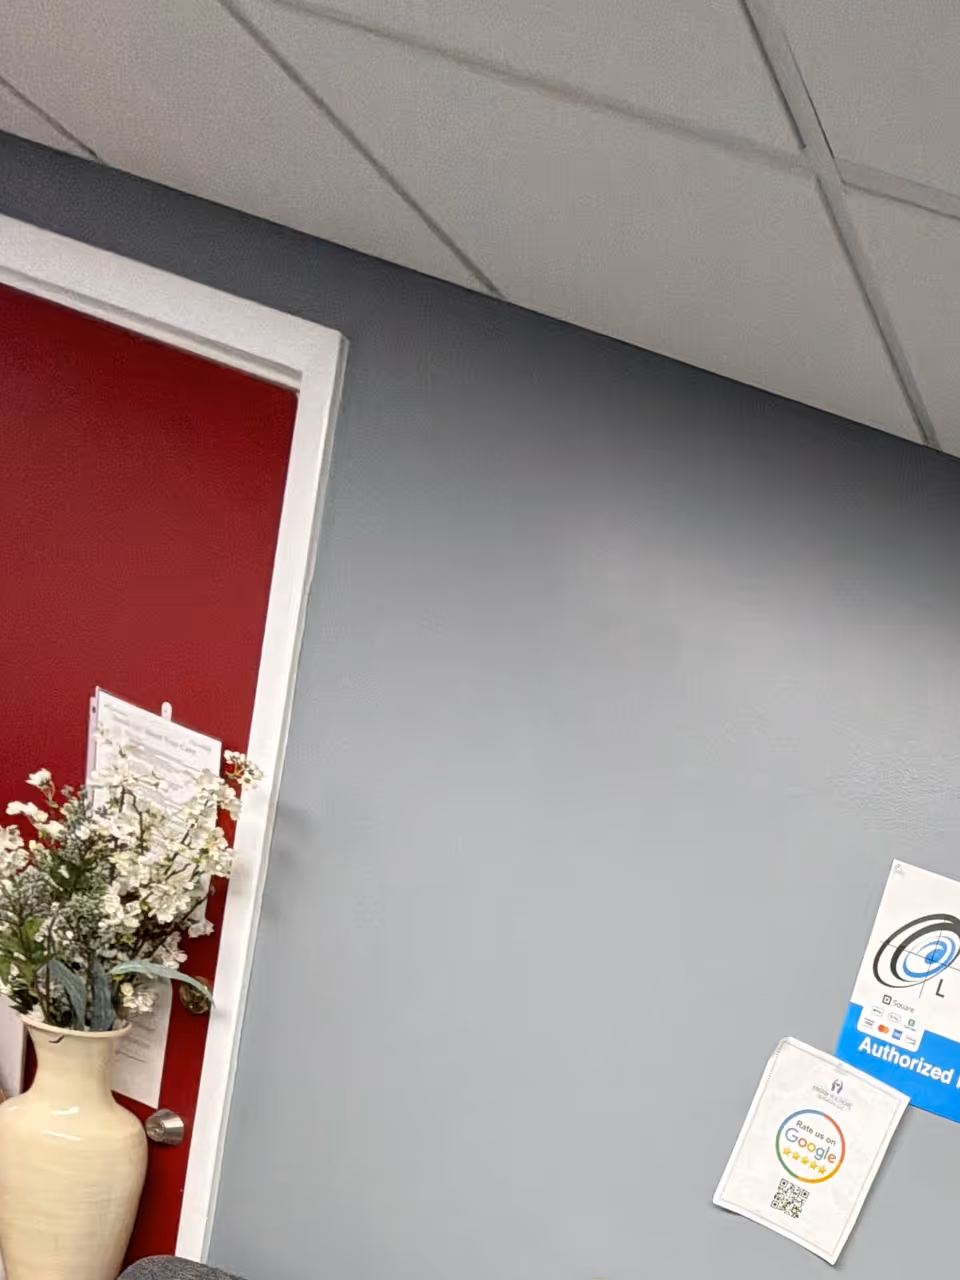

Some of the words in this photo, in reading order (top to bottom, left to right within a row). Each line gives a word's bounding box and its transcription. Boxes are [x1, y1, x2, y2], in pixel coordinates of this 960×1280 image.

[892, 999, 915, 1013] Square
[858, 1036, 953, 1085] Authorized
[785, 1127, 836, 1163] Google
[796, 1120, 813, 1134] Rate
[815, 1132, 824, 1140] us
[826, 1137, 836, 1145] on
